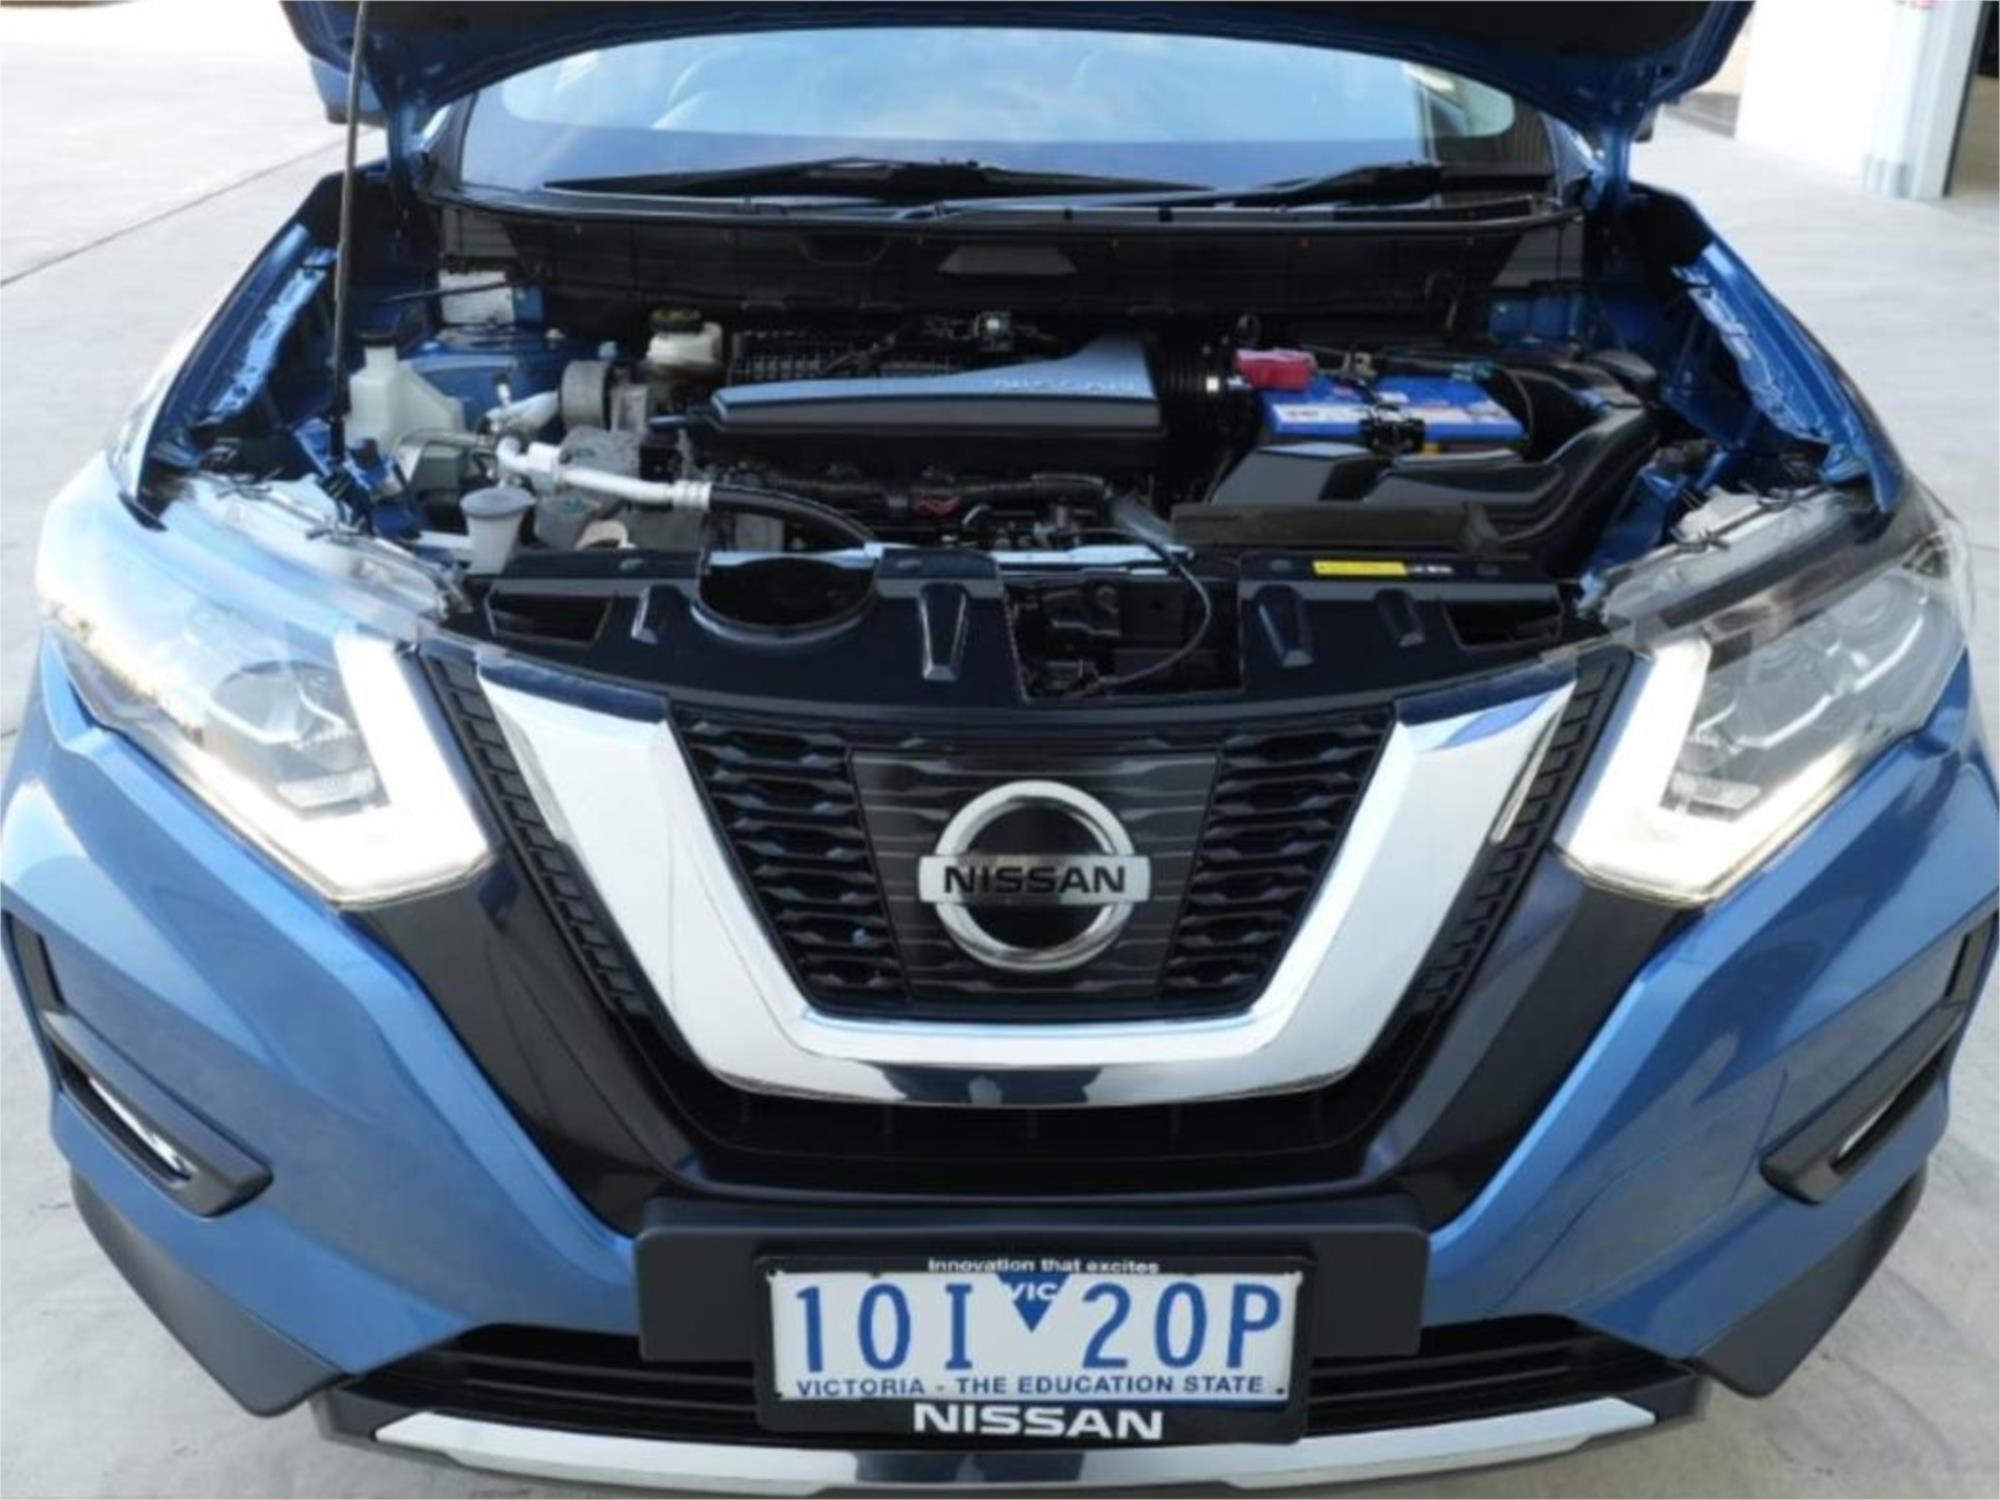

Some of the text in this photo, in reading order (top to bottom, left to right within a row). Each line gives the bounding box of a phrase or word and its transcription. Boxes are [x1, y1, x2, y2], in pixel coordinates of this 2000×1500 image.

[944, 866, 1126, 894] NISSAN
[927, 1258, 1159, 1275] Innovation that excites
[1008, 1282, 1058, 1301] VIC
[1081, 1282, 1281, 1369] 20P
[796, 1379, 925, 1397] VICTORIA
[956, 1377, 1009, 1395] THE
[1018, 1376, 1174, 1394] EDUCATION
[1184, 1376, 1263, 1393] STATE
[914, 1404, 1163, 1440] NISSAN
